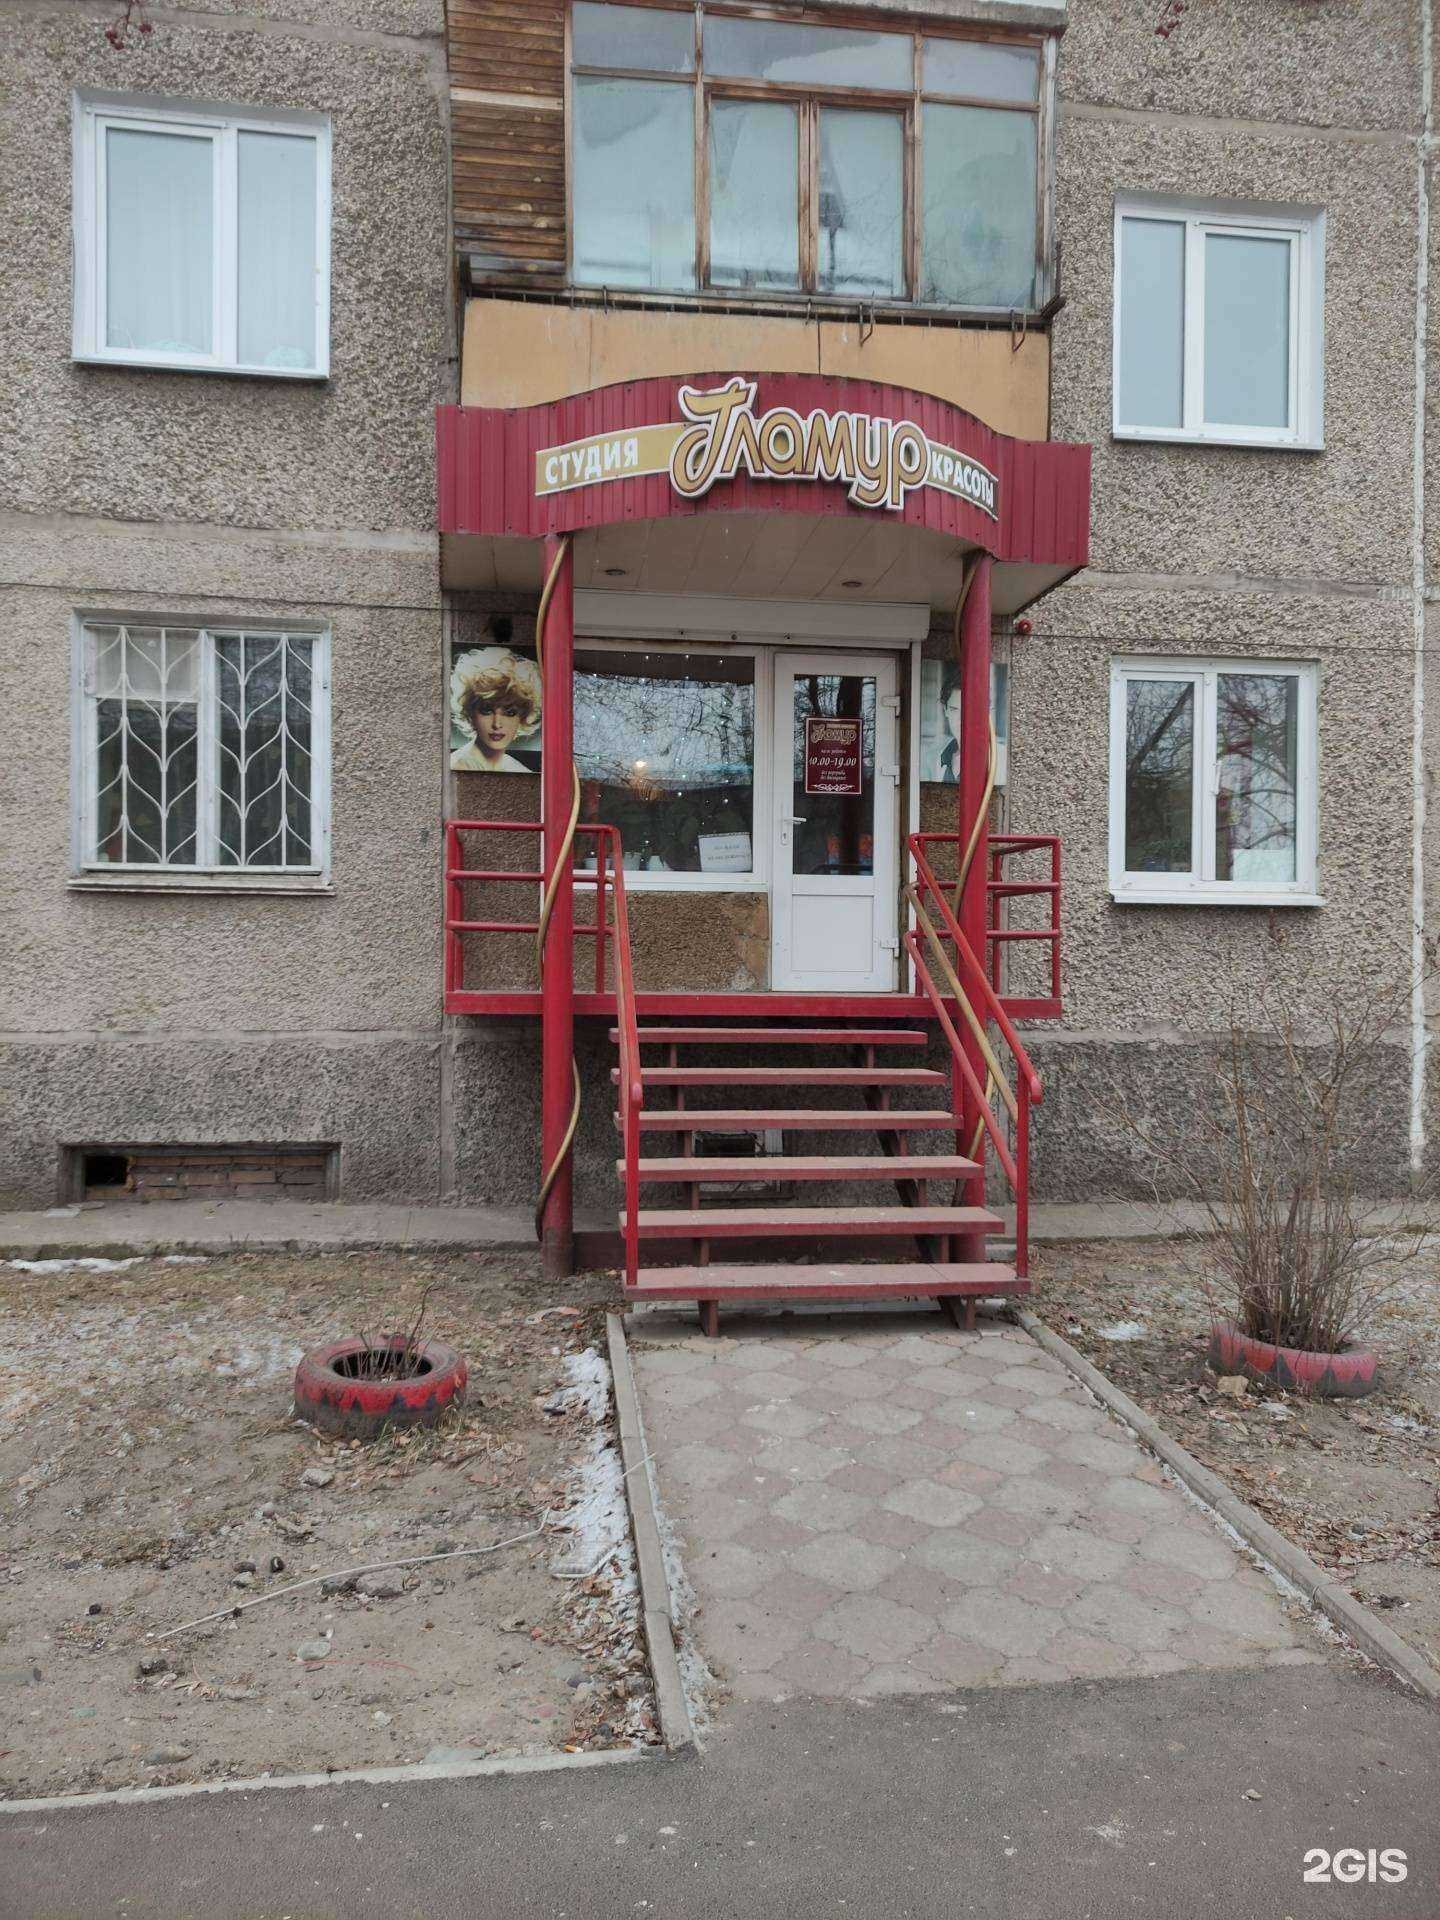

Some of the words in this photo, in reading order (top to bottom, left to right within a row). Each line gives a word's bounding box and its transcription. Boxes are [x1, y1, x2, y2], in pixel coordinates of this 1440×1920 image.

[545, 437, 639, 484] СТУДИЯ
[671, 377, 932, 509] Гламур
[931, 451, 994, 508] КРАСОТЫ
